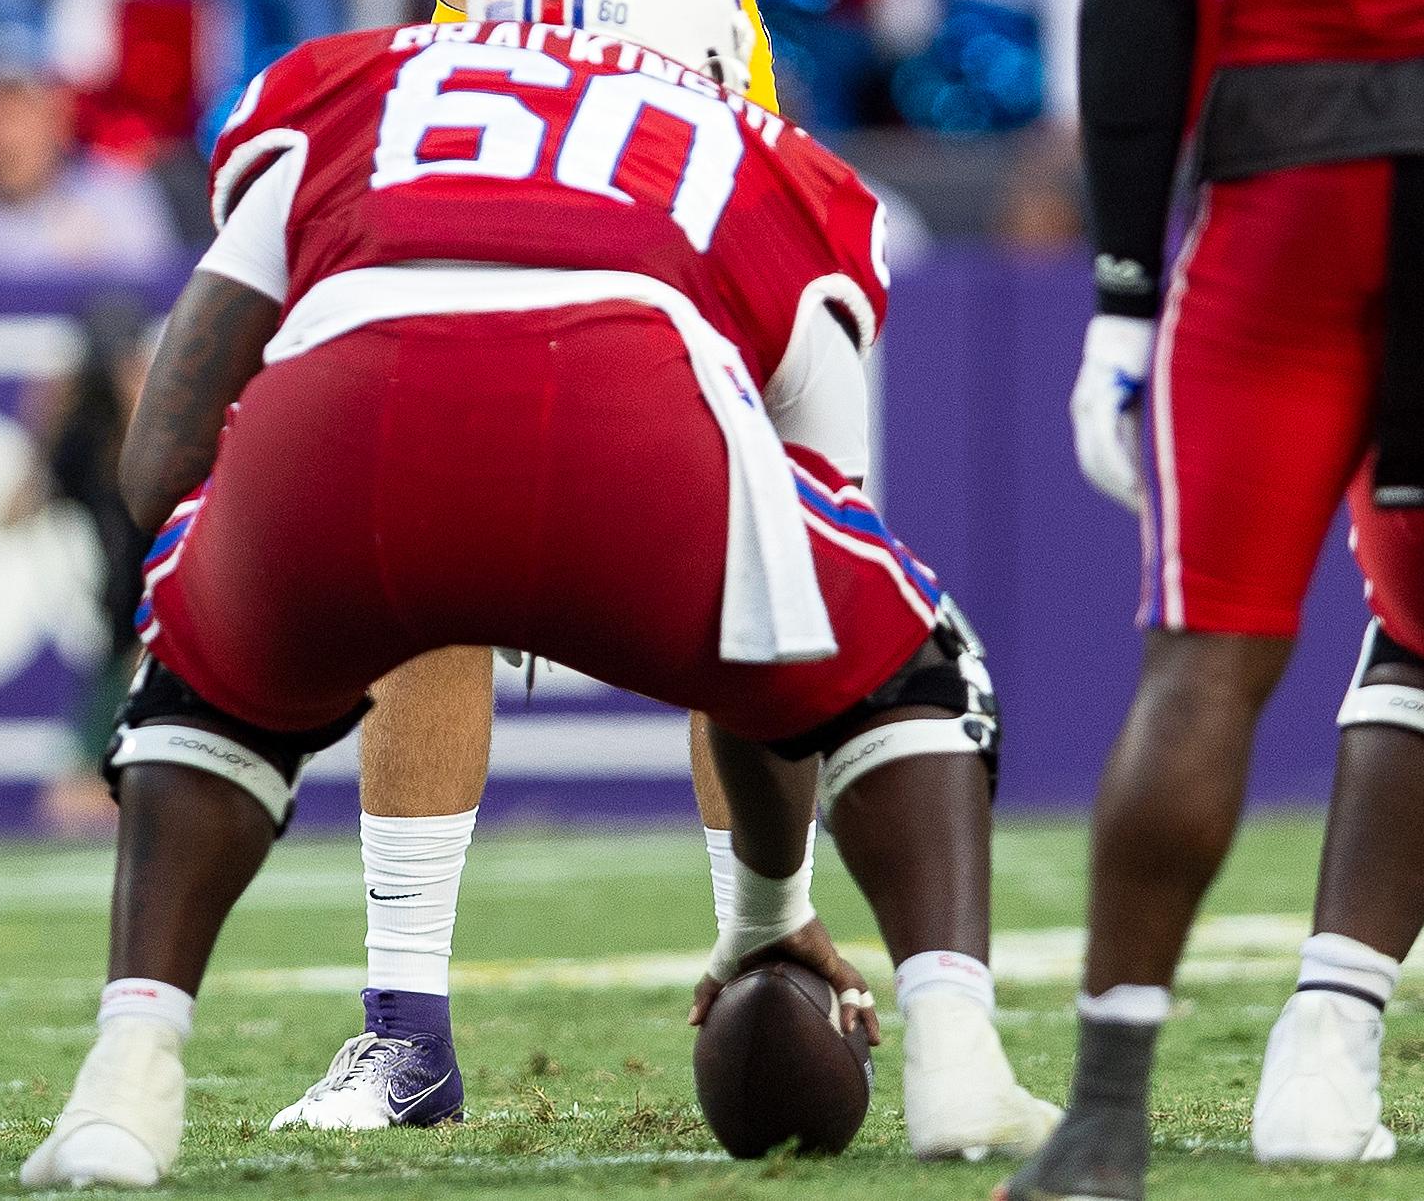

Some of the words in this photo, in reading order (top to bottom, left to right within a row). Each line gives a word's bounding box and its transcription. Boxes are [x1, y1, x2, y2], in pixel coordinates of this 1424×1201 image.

[597, 0, 628, 26] 60
[369, 38, 746, 255] 60
[168, 735, 253, 769] DONJOY
